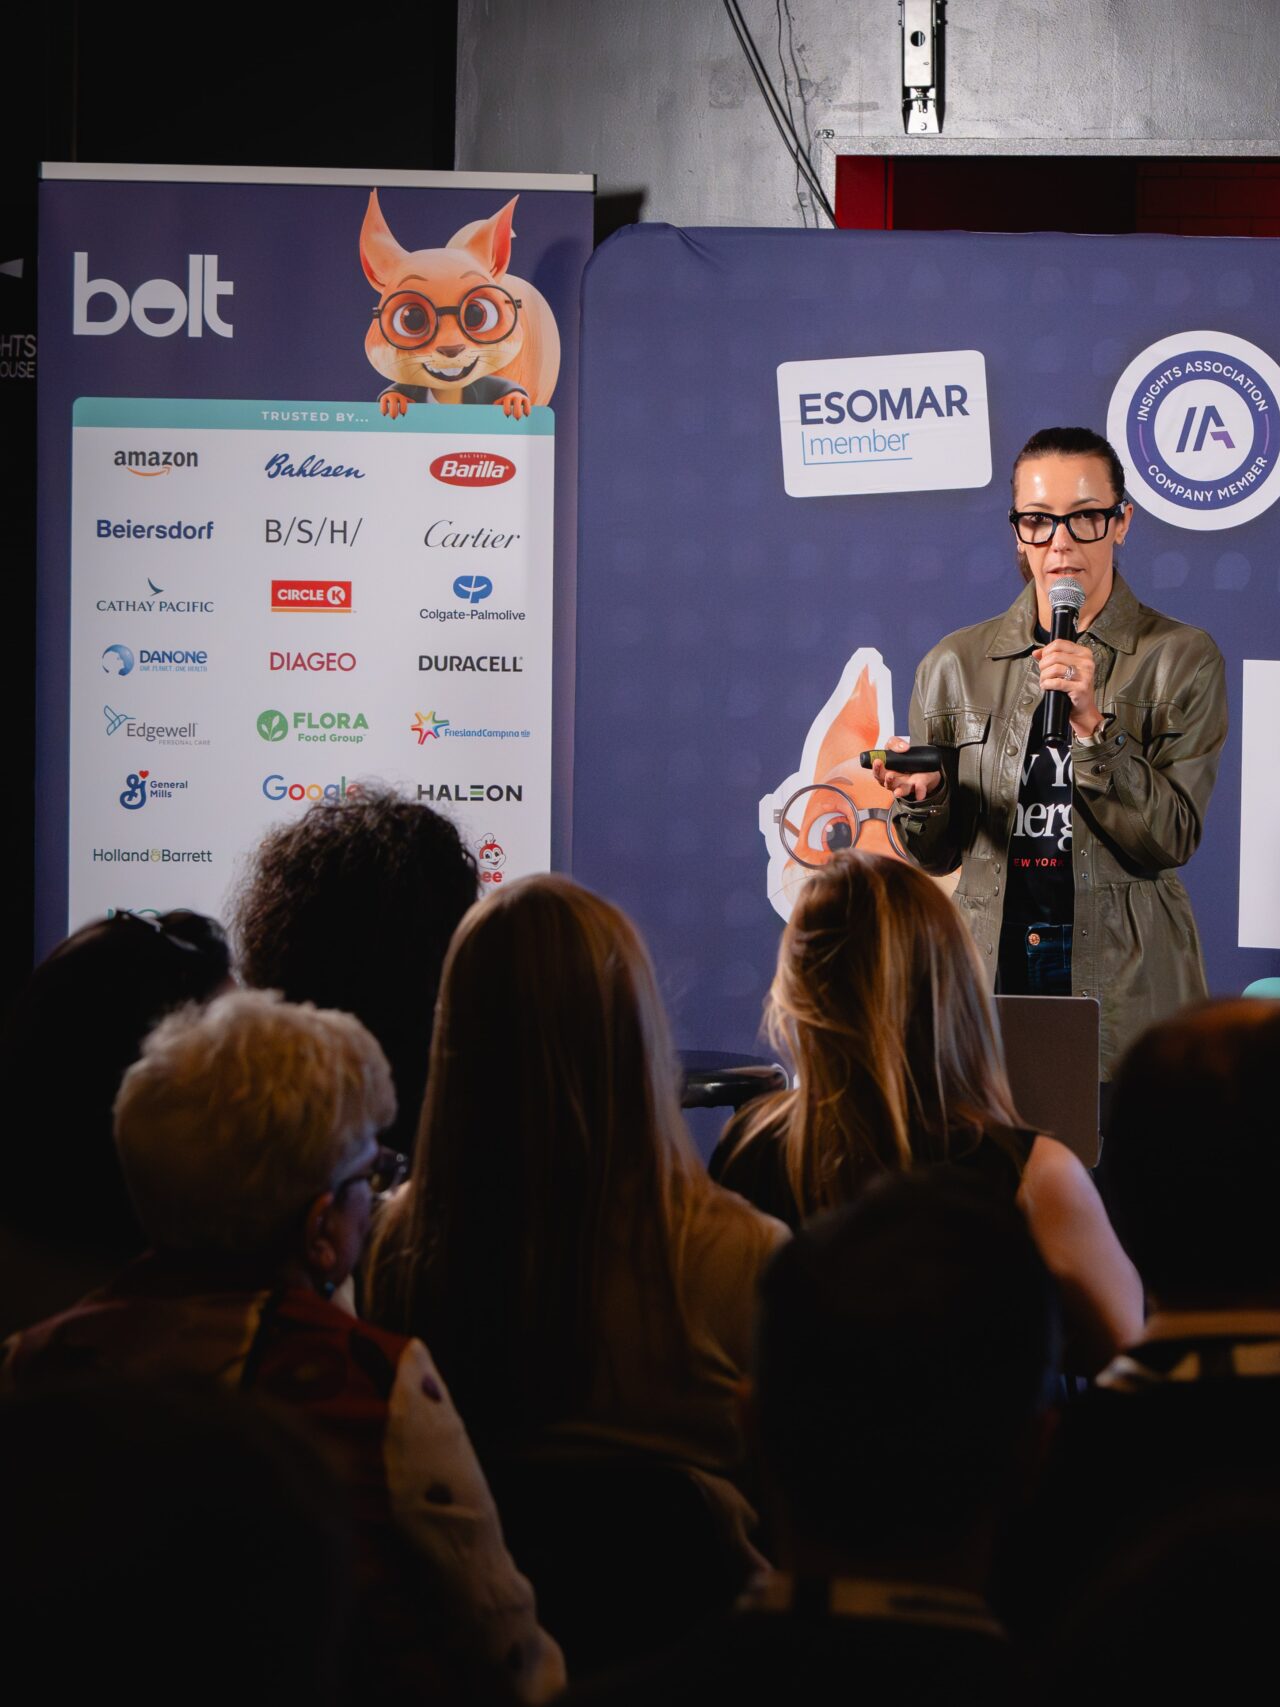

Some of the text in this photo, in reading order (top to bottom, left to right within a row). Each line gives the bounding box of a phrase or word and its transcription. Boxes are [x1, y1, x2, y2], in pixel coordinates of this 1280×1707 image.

[73, 252, 233, 338] bolt
[0, 334, 36, 358] HTS
[0, 361, 36, 378] OUSE
[1137, 361, 1268, 421] INSIGHTS ASSOCIATION
[799, 384, 969, 425] ESOMAR
[261, 411, 330, 422] TRUSTED
[810, 428, 910, 455] member
[114, 450, 199, 467] amazon
[265, 453, 365, 478] Bahlsen
[440, 460, 505, 478] Barilla
[1148, 456, 1268, 502] COMPANY MEMBER
[96, 519, 214, 540] Beiersdorf
[265, 516, 363, 547] B/S/H/
[424, 519, 521, 548] Cartier
[277, 589, 324, 601] CIRCLE
[96, 600, 215, 613] CATHAY PACIFIC
[419, 608, 526, 622] Colgate-Palmolive
[270, 652, 356, 671] DIAGEO
[418, 655, 523, 672] DURACELL
[293, 712, 369, 730] FLORA
[127, 722, 196, 742] Edgewell
[298, 733, 364, 744] Food Group
[150, 780, 188, 789] General
[150, 789, 172, 798] Mills
[417, 784, 523, 802] HALEON
